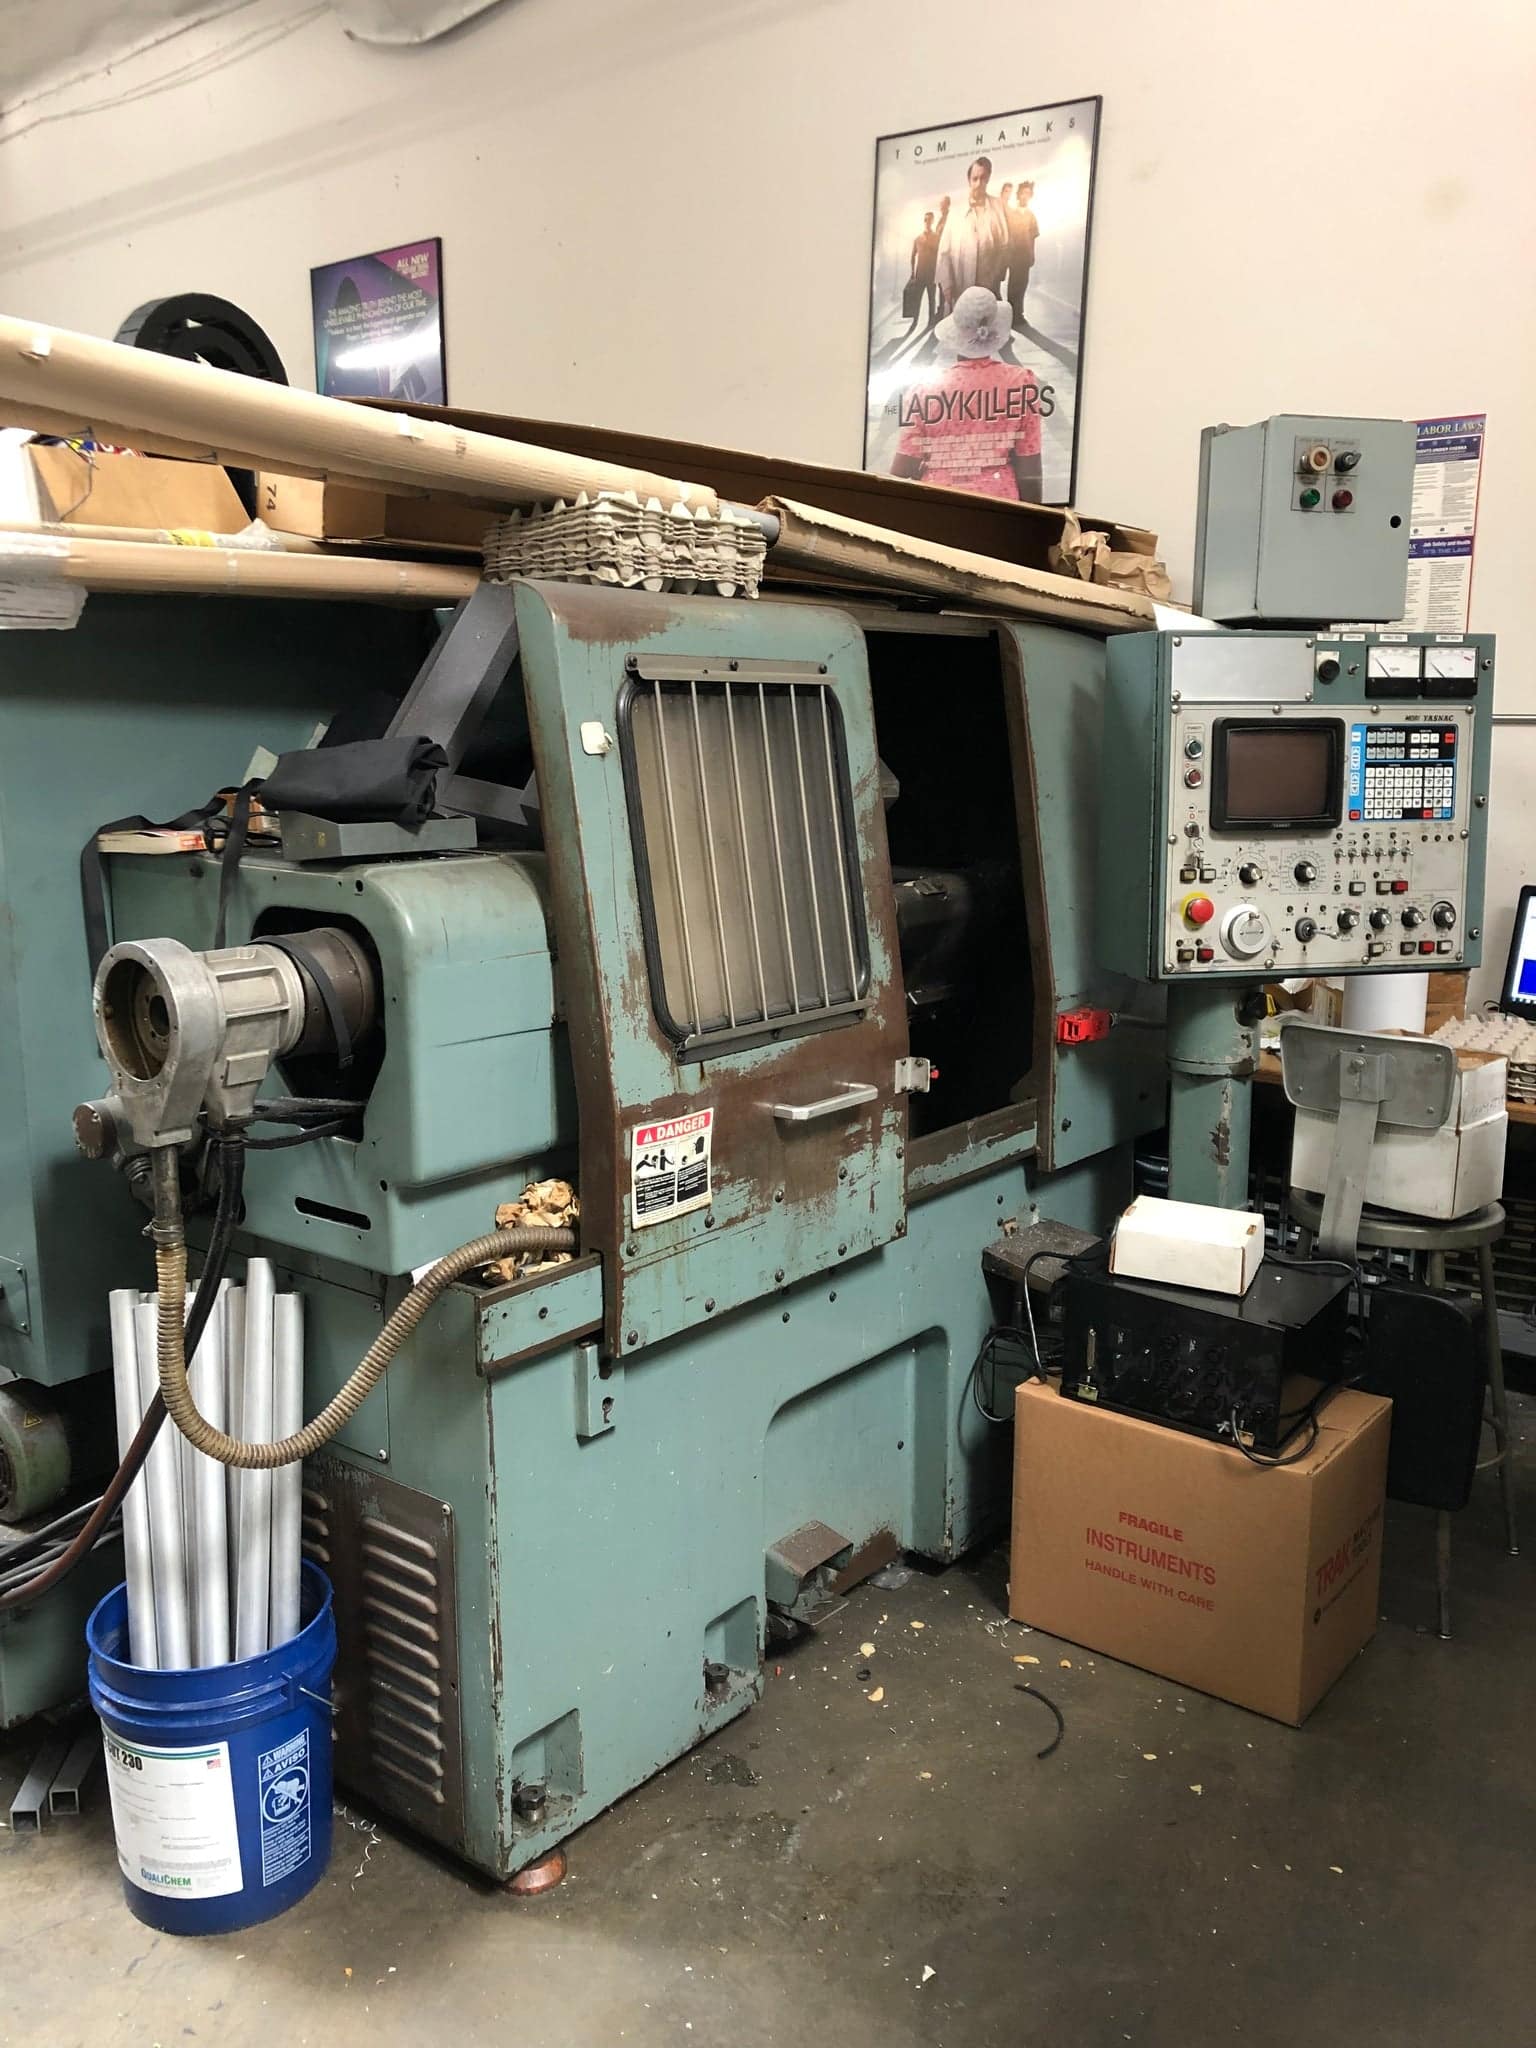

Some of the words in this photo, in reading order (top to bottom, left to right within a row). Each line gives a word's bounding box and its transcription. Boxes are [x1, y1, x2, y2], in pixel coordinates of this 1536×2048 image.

[895, 141, 947, 160] TOM
[976, 117, 1075, 145] HANKS
[884, 404, 897, 416] THE
[898, 384, 1056, 427] LADYKILLERS
[1416, 424, 1451, 436] LABOR
[1455, 423, 1484, 433] LAWS
[1423, 714, 1454, 722] YASNAC
[656, 1115, 706, 1140] DANGER
[1118, 1511, 1184, 1542] FRAGILE
[1086, 1527, 1217, 1586] INSTRUMENTS
[1316, 1537, 1351, 1597] TRAK
[1084, 1558, 1137, 1586] HANDLE
[1140, 1577, 1174, 1599] WITH
[1178, 1590, 1215, 1612] CARE
[121, 1750, 143, 1771] 230
[272, 1734, 305, 1761] WARNING
[273, 1748, 306, 1774] AVISO
